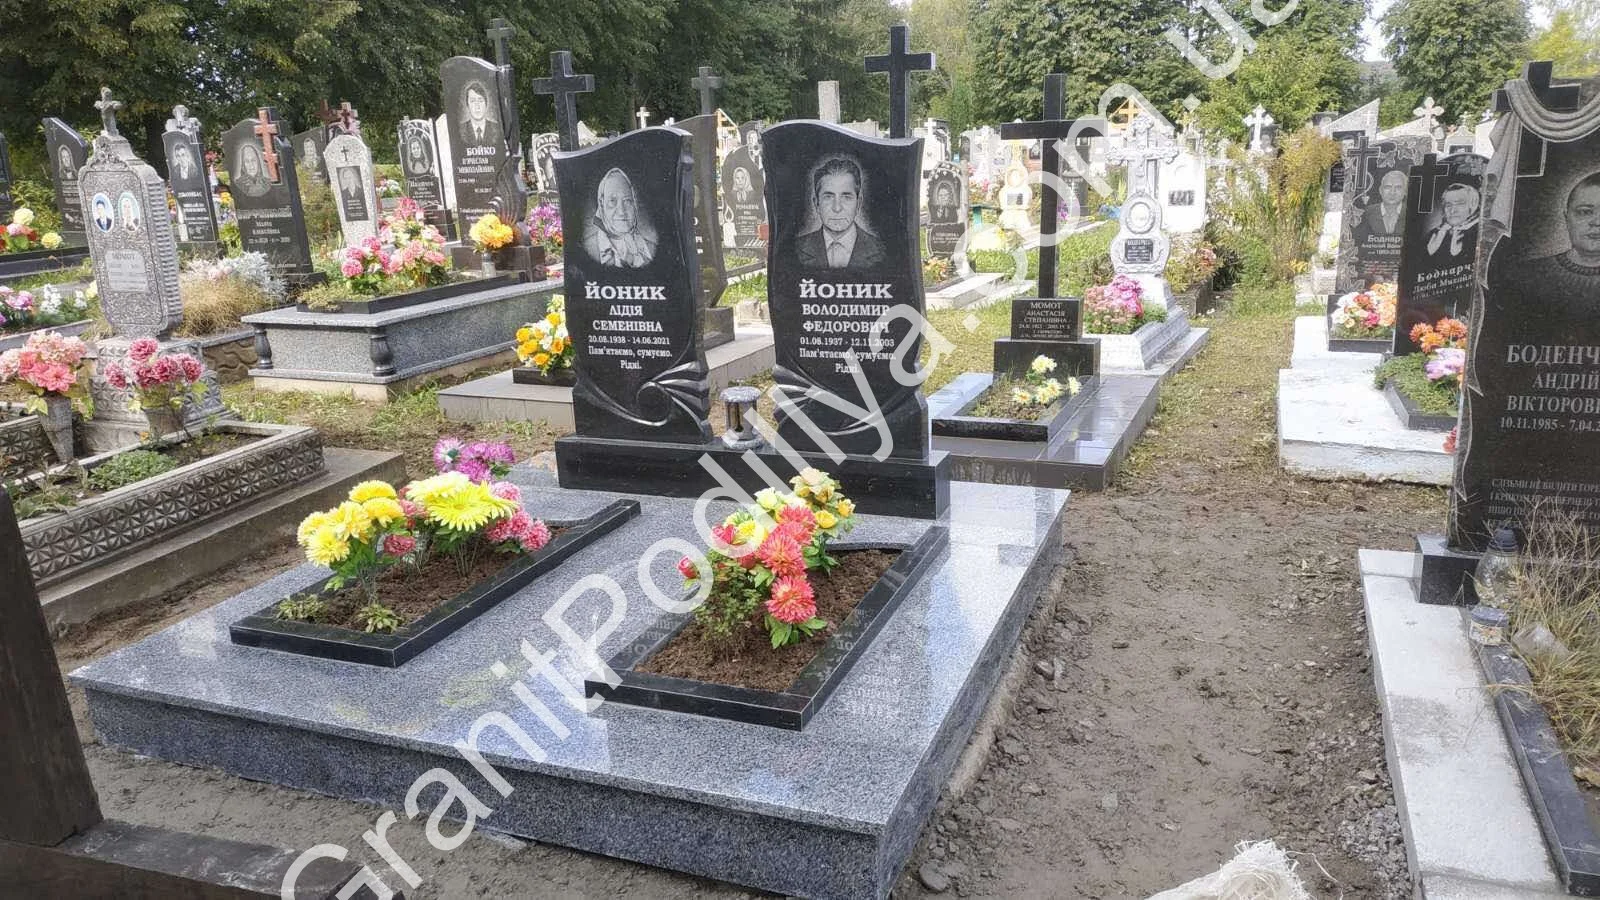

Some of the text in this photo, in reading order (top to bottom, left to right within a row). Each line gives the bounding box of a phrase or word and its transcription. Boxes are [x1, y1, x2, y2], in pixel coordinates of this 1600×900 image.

[584, 281, 667, 300] ЙОНИК
[799, 278, 893, 299] ЙОНИК
[609, 305, 643, 317] ЛІДІЯ
[802, 304, 890, 317] ВОЛОДИМИР
[592, 320, 664, 332] СЕМЕНІВНА
[803, 320, 890, 334] ФЕДОРОВИЧ
[632, 336, 670, 345] 14.06.2021
[851, 338, 895, 347] 12.11.2003
[1532, 370, 1600, 392] АНДРІЙ
[1500, 416, 1559, 430] 10.11.1985
